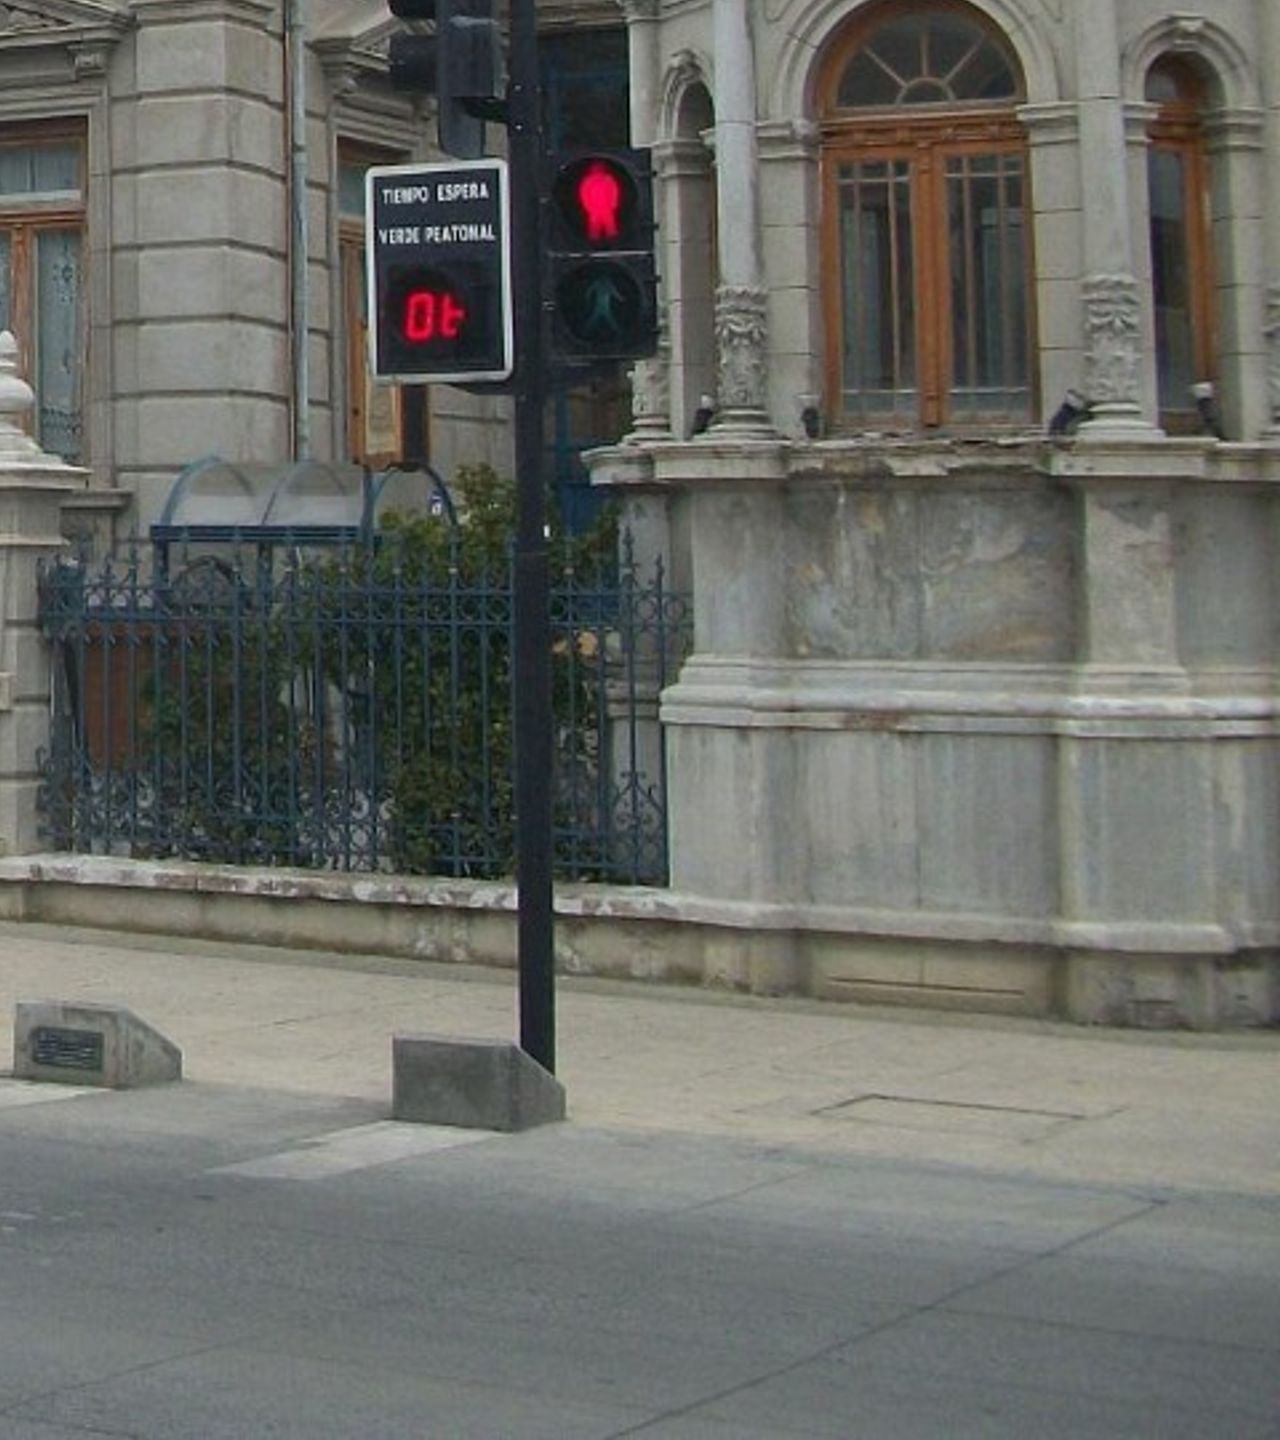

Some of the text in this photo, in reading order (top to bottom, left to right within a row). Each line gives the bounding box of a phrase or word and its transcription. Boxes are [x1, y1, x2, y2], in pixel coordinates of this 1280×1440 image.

[382, 183, 489, 204] TIEMPO ESPERA
[378, 224, 496, 244] VERDE PEATONAL
